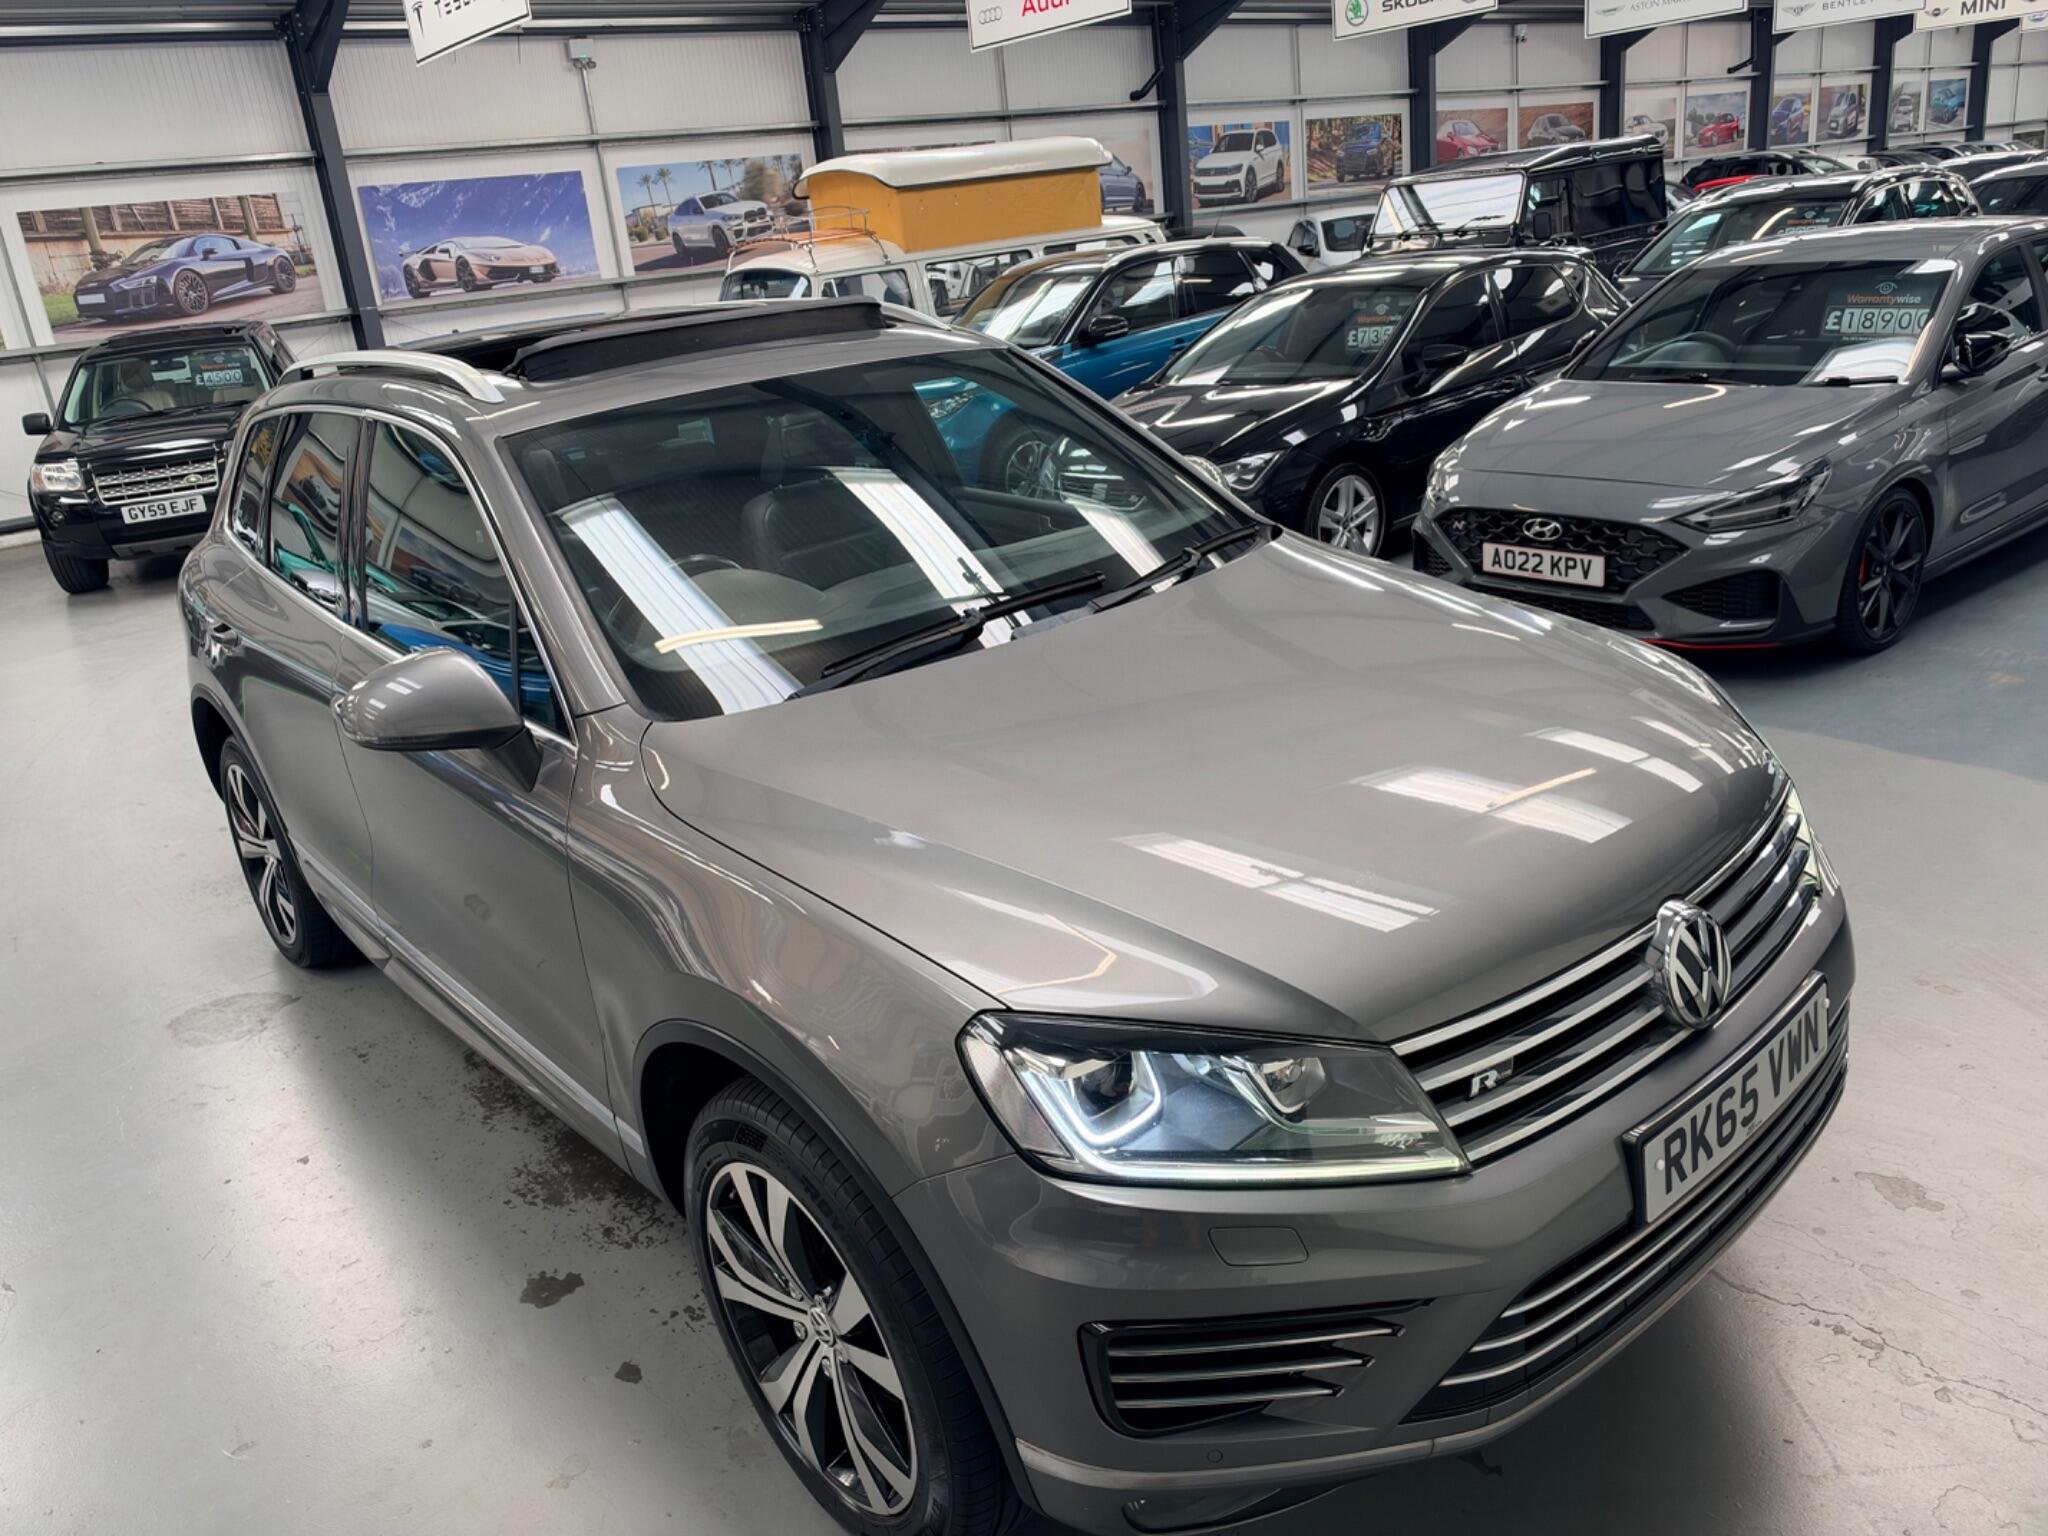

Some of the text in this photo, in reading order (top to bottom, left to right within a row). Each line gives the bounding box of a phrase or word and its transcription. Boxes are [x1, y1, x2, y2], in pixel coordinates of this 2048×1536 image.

[1022, 0, 1069, 17] Au
[1382, 0, 1434, 12] SKO
[1961, 0, 2006, 15] MINI
[1847, 294, 1922, 305] Warrantywise
[129, 499, 200, 521] GY59 EJF
[1550, 556, 1592, 580] KPV
[1664, 1003, 1819, 1195] RK65 VWN
